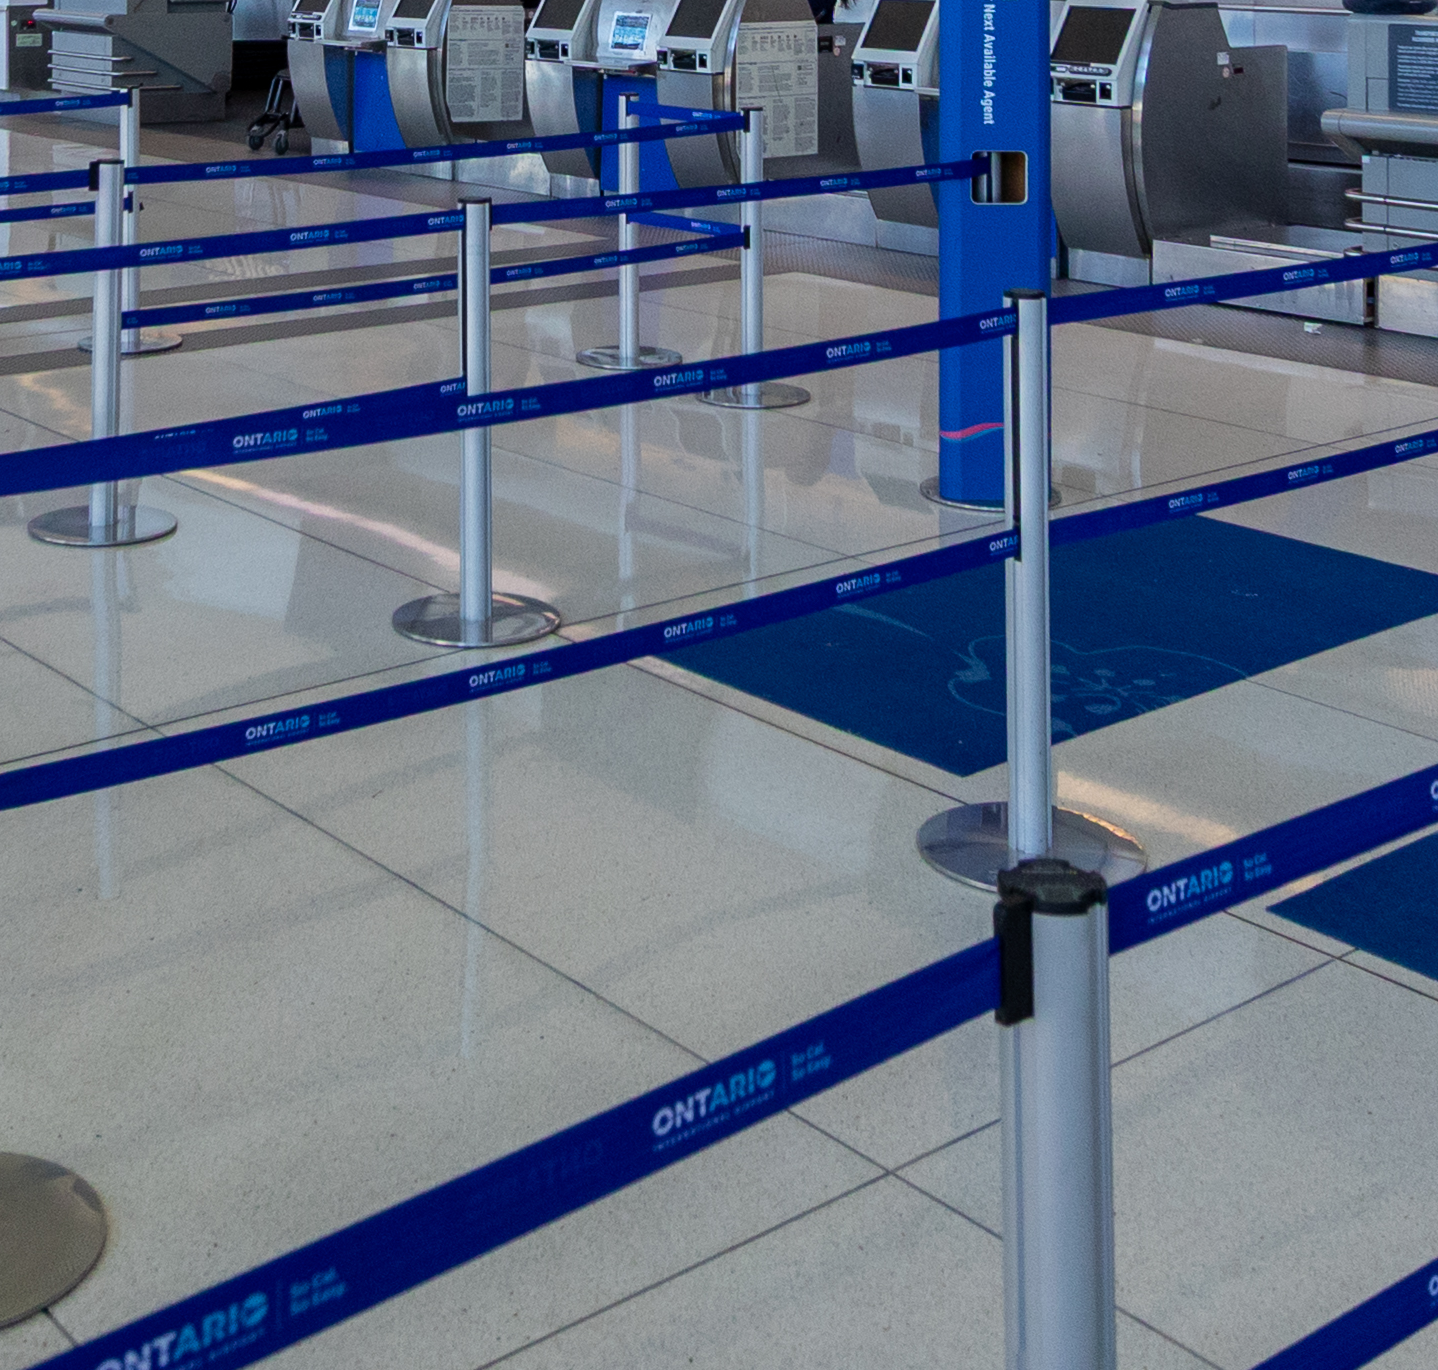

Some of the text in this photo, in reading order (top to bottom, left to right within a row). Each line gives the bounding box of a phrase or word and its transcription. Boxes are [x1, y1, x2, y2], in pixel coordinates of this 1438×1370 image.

[983, 3, 997, 32] Next
[983, 33, 997, 88] Available
[980, 89, 996, 126] Agent
[232, 428, 299, 449] ONTARIO
[468, 662, 526, 688] ONTARIO
[244, 714, 312, 741] ONTARIO
[1146, 859, 1234, 913] ONTARIO
[652, 1059, 777, 1138] ONTARIO
